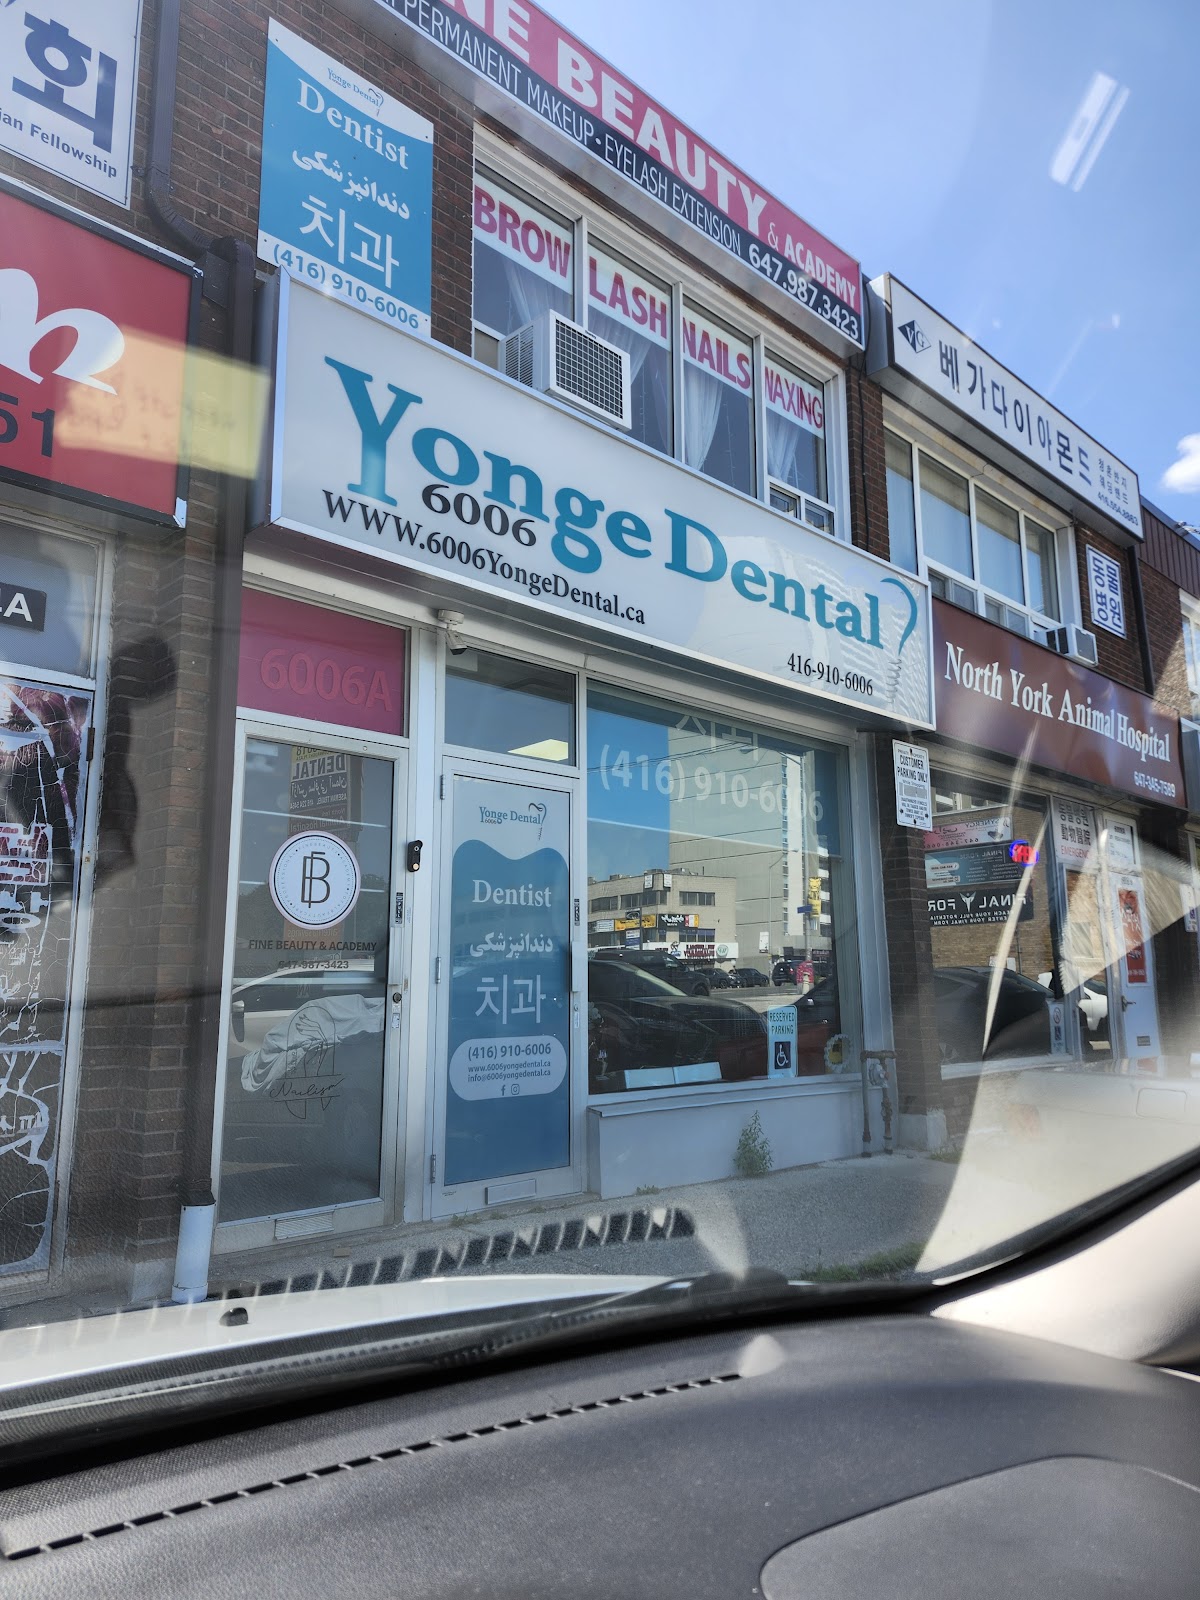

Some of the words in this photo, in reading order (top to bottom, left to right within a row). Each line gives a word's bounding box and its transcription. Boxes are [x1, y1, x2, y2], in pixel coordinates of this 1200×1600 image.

[12, 11, 117, 153] 회
[328, 68, 351, 89] Yonge
[353, 84, 380, 107] Dental
[297, 78, 409, 170] Dentist
[30, 123, 117, 178] Fellowship
[404, 0, 522, 95] PERMANENT
[527, 77, 595, 145] MAKEUP
[605, 133, 668, 202] EYELASH
[673, 182, 741, 256] EXTENSION
[748, 243, 859, 340] 647.987.3423
[557, 37, 767, 237] BEAUTY
[768, 221, 779, 251] &
[784, 233, 856, 307] ACADEMY
[299, 195, 400, 289] 치과
[273, 244, 326, 284] (416)
[331, 273, 419, 329] 910-6006
[474, 185, 571, 279] BROW
[588, 256, 668, 340] LASH
[682, 316, 751, 390] NAILS
[764, 366, 823, 429] WAXING
[938, 340, 1092, 487] 베가다이아몬드
[324, 355, 652, 574] Yonge
[664, 508, 884, 650] Dental
[421, 483, 537, 547] 6006
[0, 592, 33, 623] A
[259, 647, 393, 713] 6006A
[787, 652, 874, 696] 416-910-6006
[944, 641, 1003, 701] North
[1009, 668, 1054, 718] York
[1057, 688, 1115, 740] Animal
[1116, 712, 1171, 763] Hospital
[600, 743, 686, 803] (416)
[897, 766, 917, 781] PARKING
[917, 771, 928, 783] ONLY
[899, 754, 924, 770] CUSTOMER
[479, 806, 508, 825] Yonge
[510, 810, 541, 825] Dental
[472, 879, 552, 908] Dentist
[249, 939, 273, 950] FINE
[276, 939, 317, 951] BEAUTY
[319, 941, 327, 951] &
[329, 941, 377, 951] ACADEMY
[278, 960, 350, 970] 647-987-3423
[470, 931, 554, 960] دندانپزشکی
[475, 974, 547, 1025] 치과
[769, 1011, 795, 1022] RESERVED
[468, 1045, 498, 1062] (416)
[501, 1043, 552, 1058] 910-6006
[771, 1025, 794, 1035] PARKING
[467, 1069, 551, 1083] info@6006yongedental.ca
[468, 1059, 551, 1073] www.6006yongedental.ca
